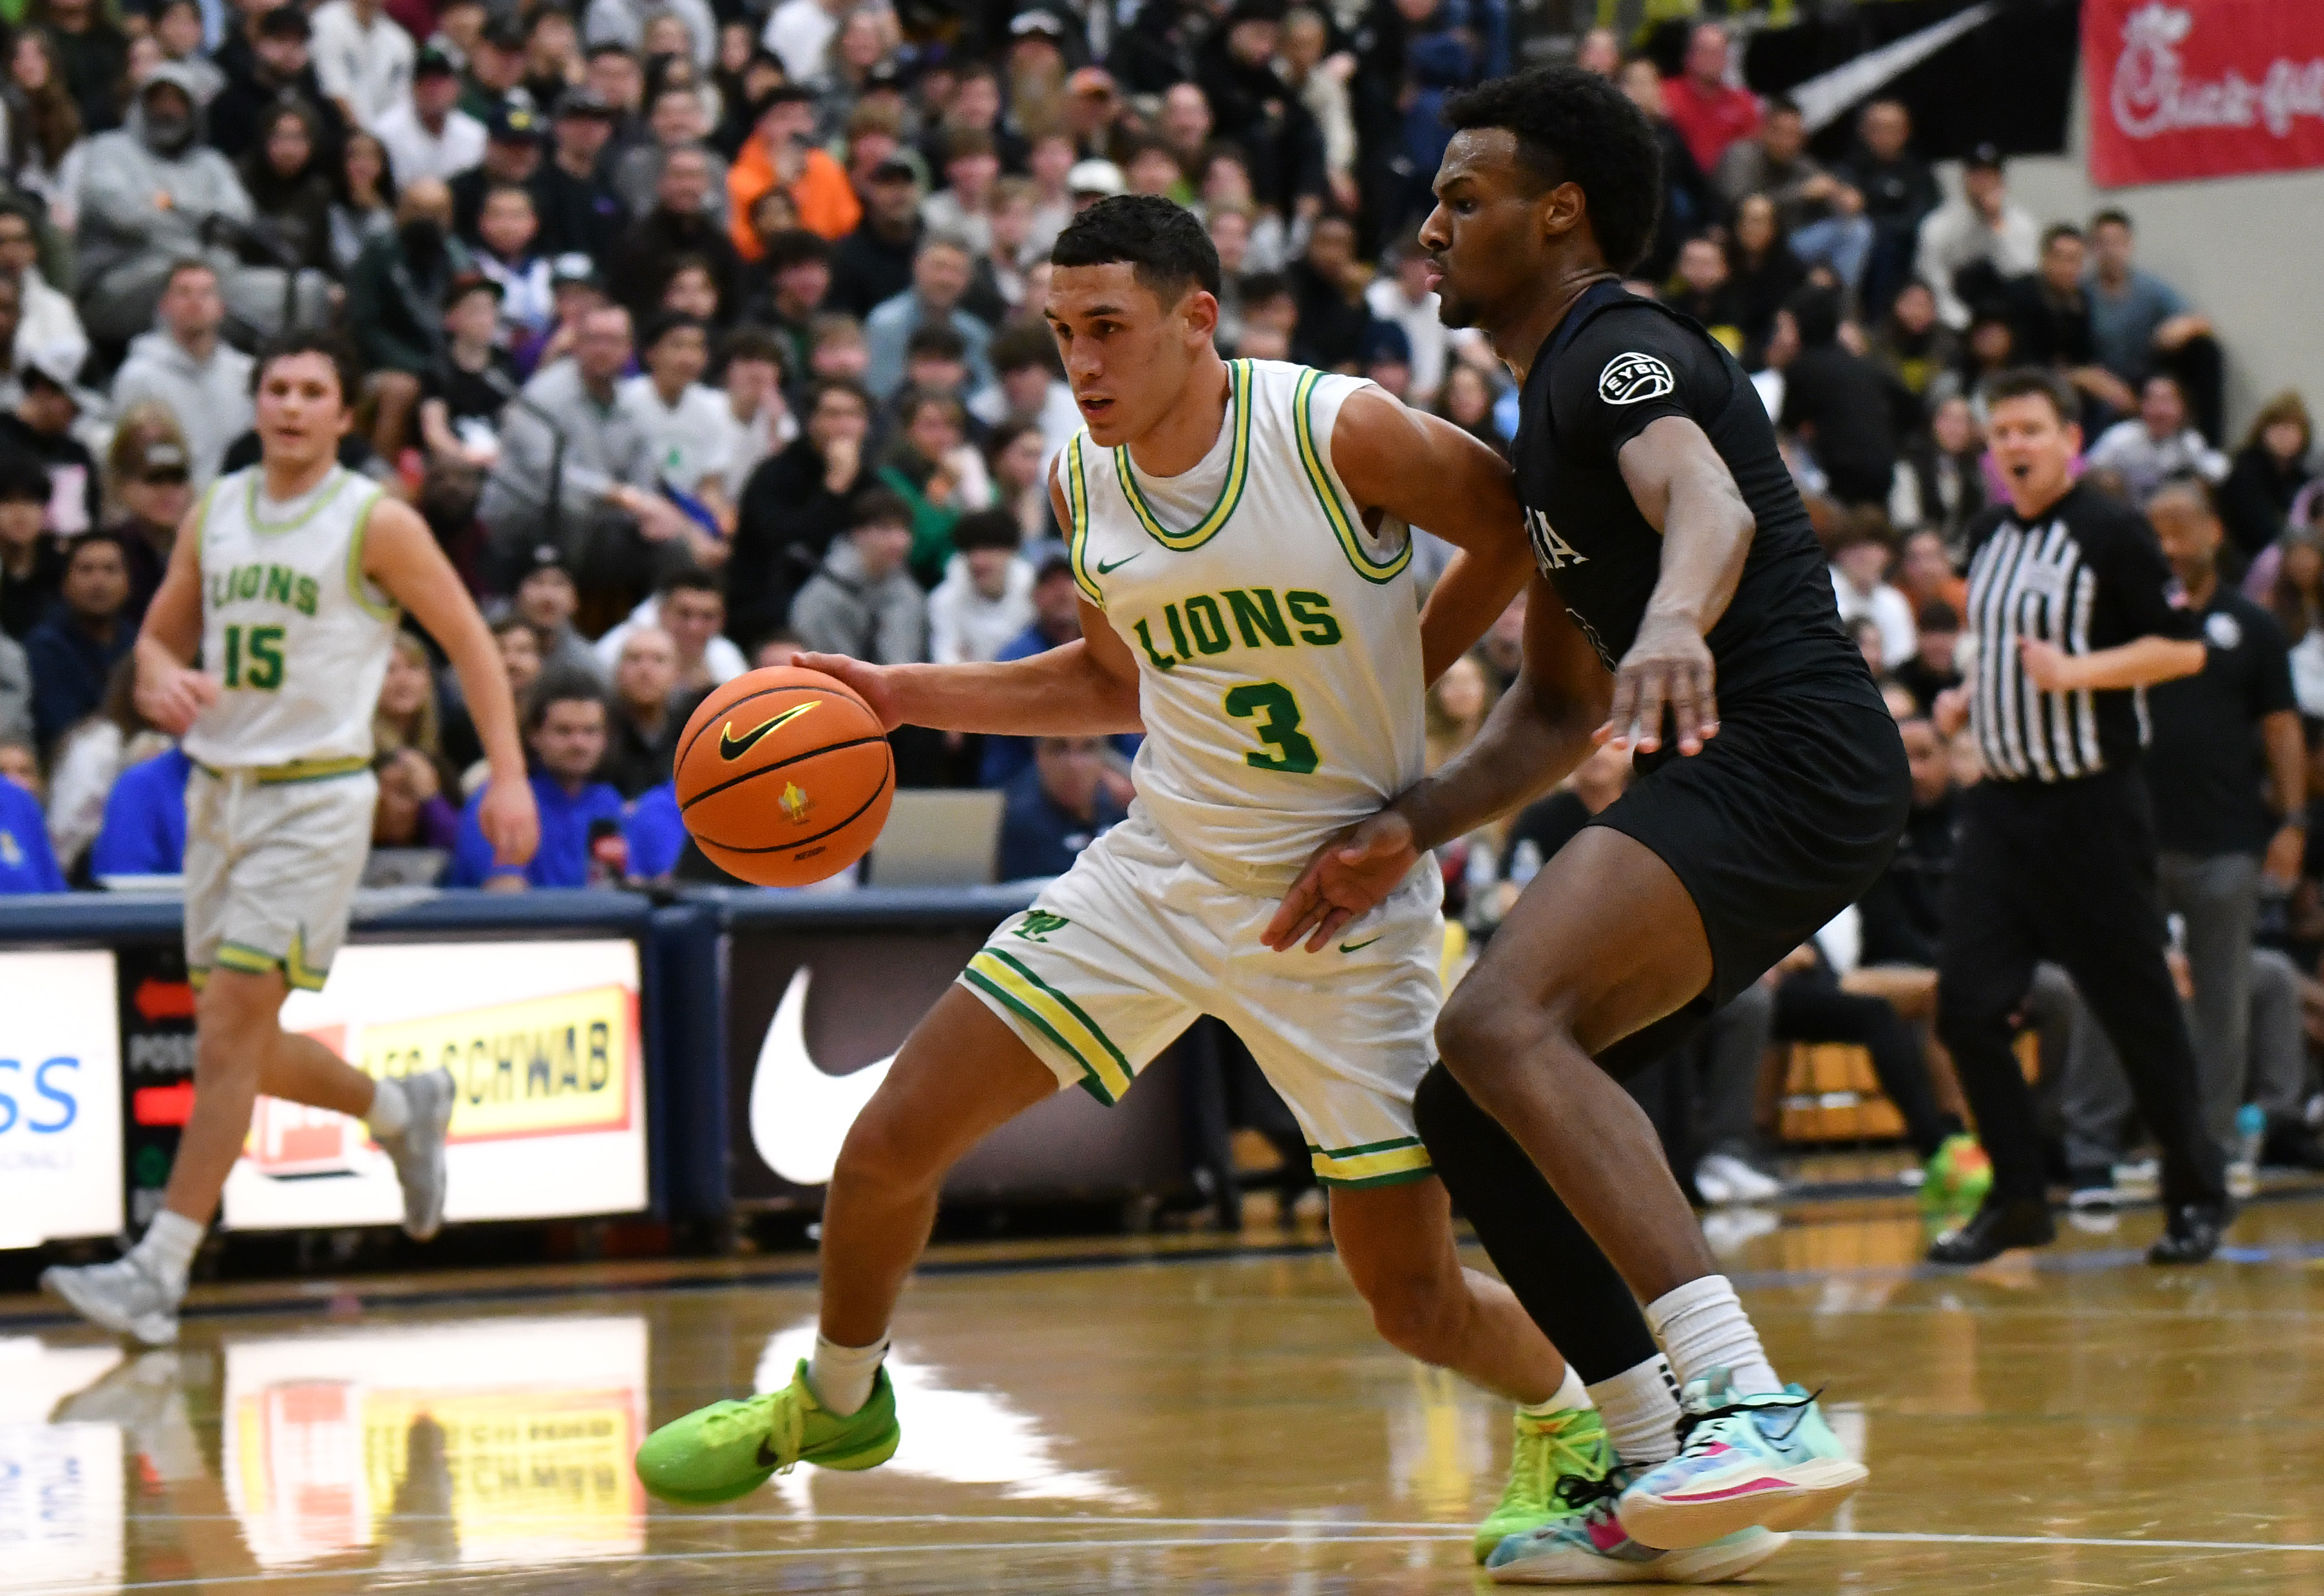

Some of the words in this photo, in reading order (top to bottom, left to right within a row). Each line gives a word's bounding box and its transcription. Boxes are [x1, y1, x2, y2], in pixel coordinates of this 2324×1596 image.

[1606, 363, 1665, 391] EYBL
[211, 563, 320, 617] LIONS
[225, 624, 286, 691] 15
[1133, 587, 1343, 670] LIONS
[1222, 679, 1321, 776] 3
